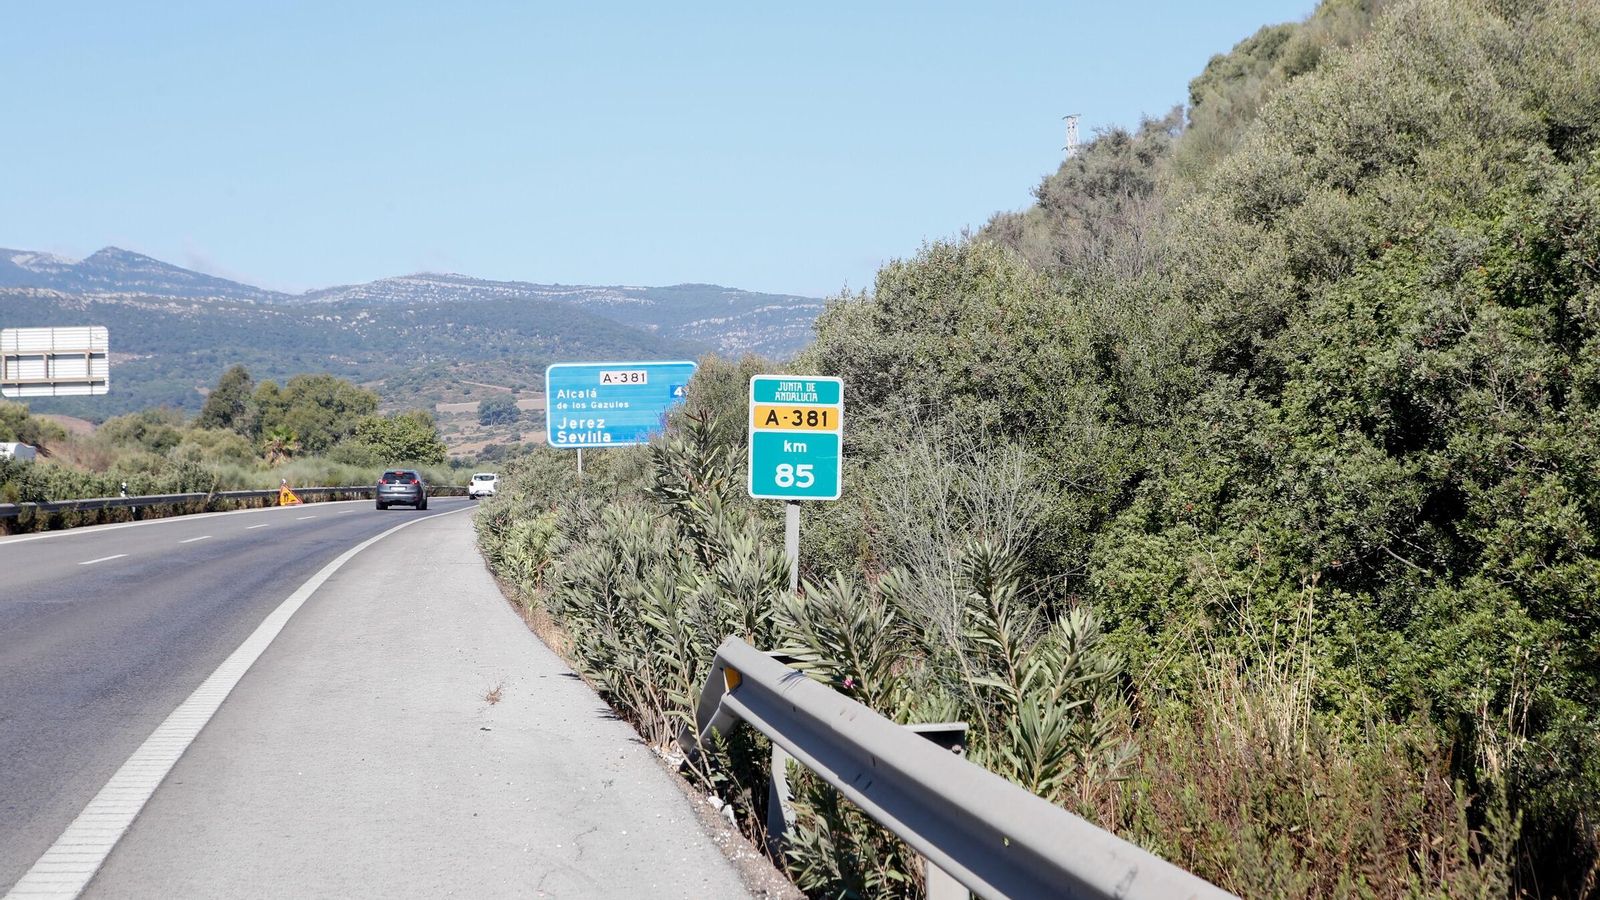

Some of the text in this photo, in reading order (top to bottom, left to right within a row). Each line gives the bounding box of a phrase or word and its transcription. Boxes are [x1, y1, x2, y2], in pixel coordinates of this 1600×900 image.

[603, 373, 646, 383] A-381
[778, 382, 816, 391] JUNTA DE
[557, 388, 597, 399] Alcalá
[557, 401, 630, 409] de los Gazules
[557, 417, 605, 429] Jerez
[765, 409, 827, 427] A-381
[557, 431, 612, 443] Sevilla
[784, 440, 807, 453] km
[775, 463, 815, 488] 85
